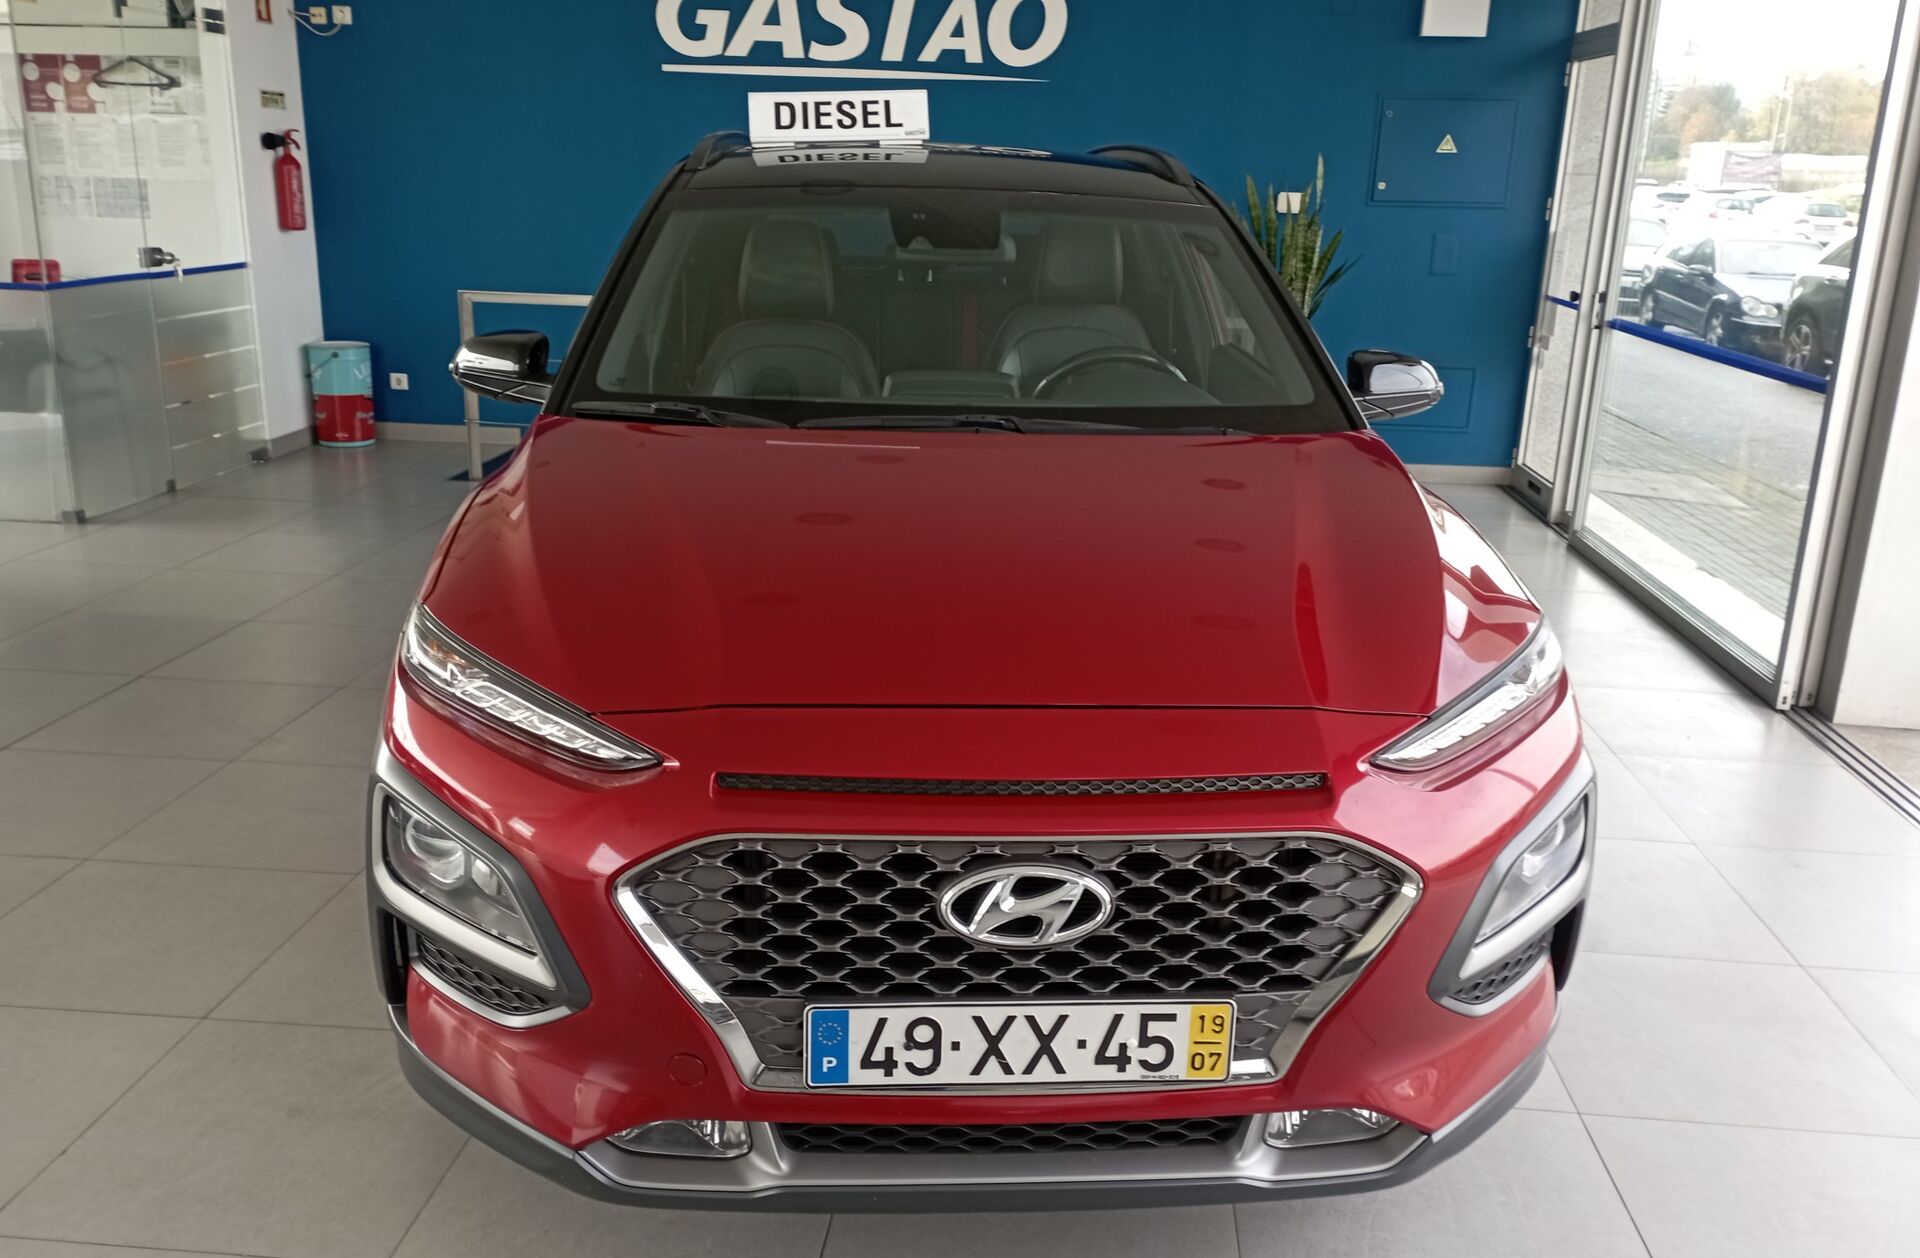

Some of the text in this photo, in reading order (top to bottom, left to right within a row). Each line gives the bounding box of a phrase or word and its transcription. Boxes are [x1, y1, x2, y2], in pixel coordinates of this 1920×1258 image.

[774, 100, 904, 130] DIESEL
[1198, 1014, 1225, 1034] 19
[822, 1057, 837, 1072] P
[1191, 1052, 1223, 1071] 07
